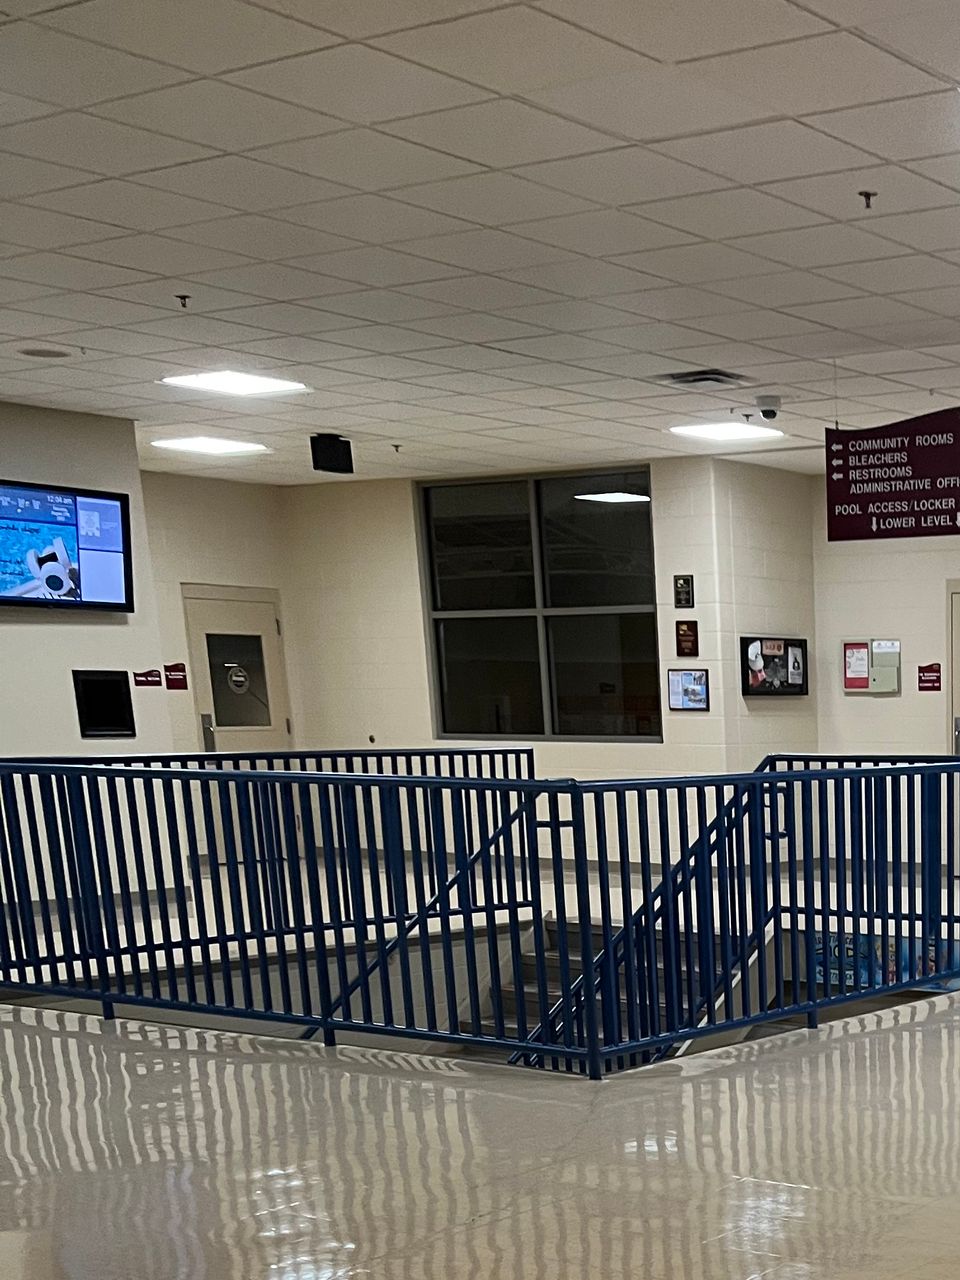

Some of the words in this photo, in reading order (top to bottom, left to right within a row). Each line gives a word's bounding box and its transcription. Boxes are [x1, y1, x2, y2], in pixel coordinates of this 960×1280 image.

[849, 438, 910, 452] COMMUNITY
[916, 433, 954, 446] ROOMS
[849, 452, 908, 466] BLEACHERS
[849, 466, 912, 480] RESTROOMS
[850, 480, 931, 494] ADMINISTRATIVE
[835, 504, 862, 516] POOL
[880, 516, 916, 529] LOWER
[921, 514, 953, 527] LEVEL
